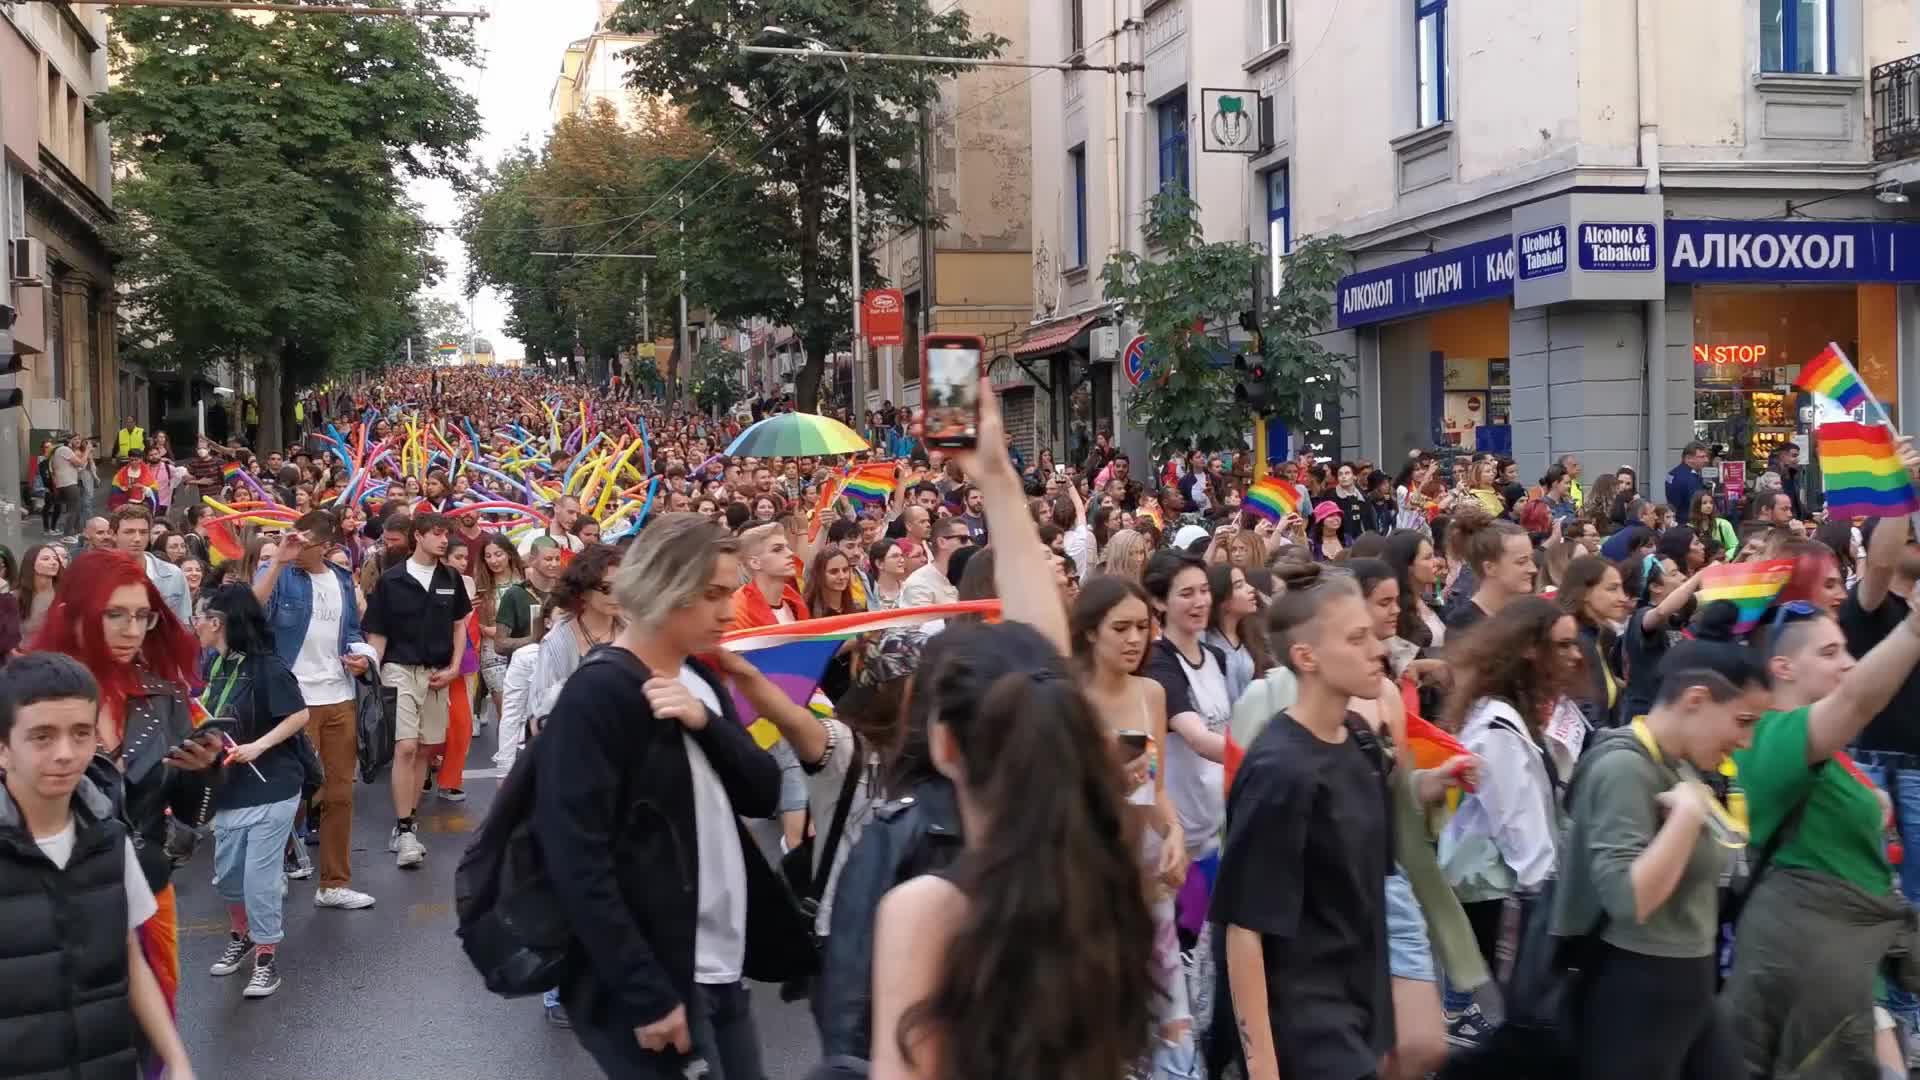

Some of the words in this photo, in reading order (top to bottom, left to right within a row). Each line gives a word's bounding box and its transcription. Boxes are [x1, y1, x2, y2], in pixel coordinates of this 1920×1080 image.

[1521, 231, 1553, 255] Alcohol
[1553, 229, 1562, 247] &
[1584, 226, 1633, 244] Alcohol
[1635, 226, 1647, 244] &
[1526, 246, 1564, 271] Tabakoff
[1591, 244, 1650, 262] Tabakoff
[1671, 233, 1855, 269] АЛКОХОЛ
[1343, 278, 1393, 314] АЛКОХОЛ
[1414, 261, 1462, 303] ЦИГАРИ
[1714, 344, 1766, 363] STOP
